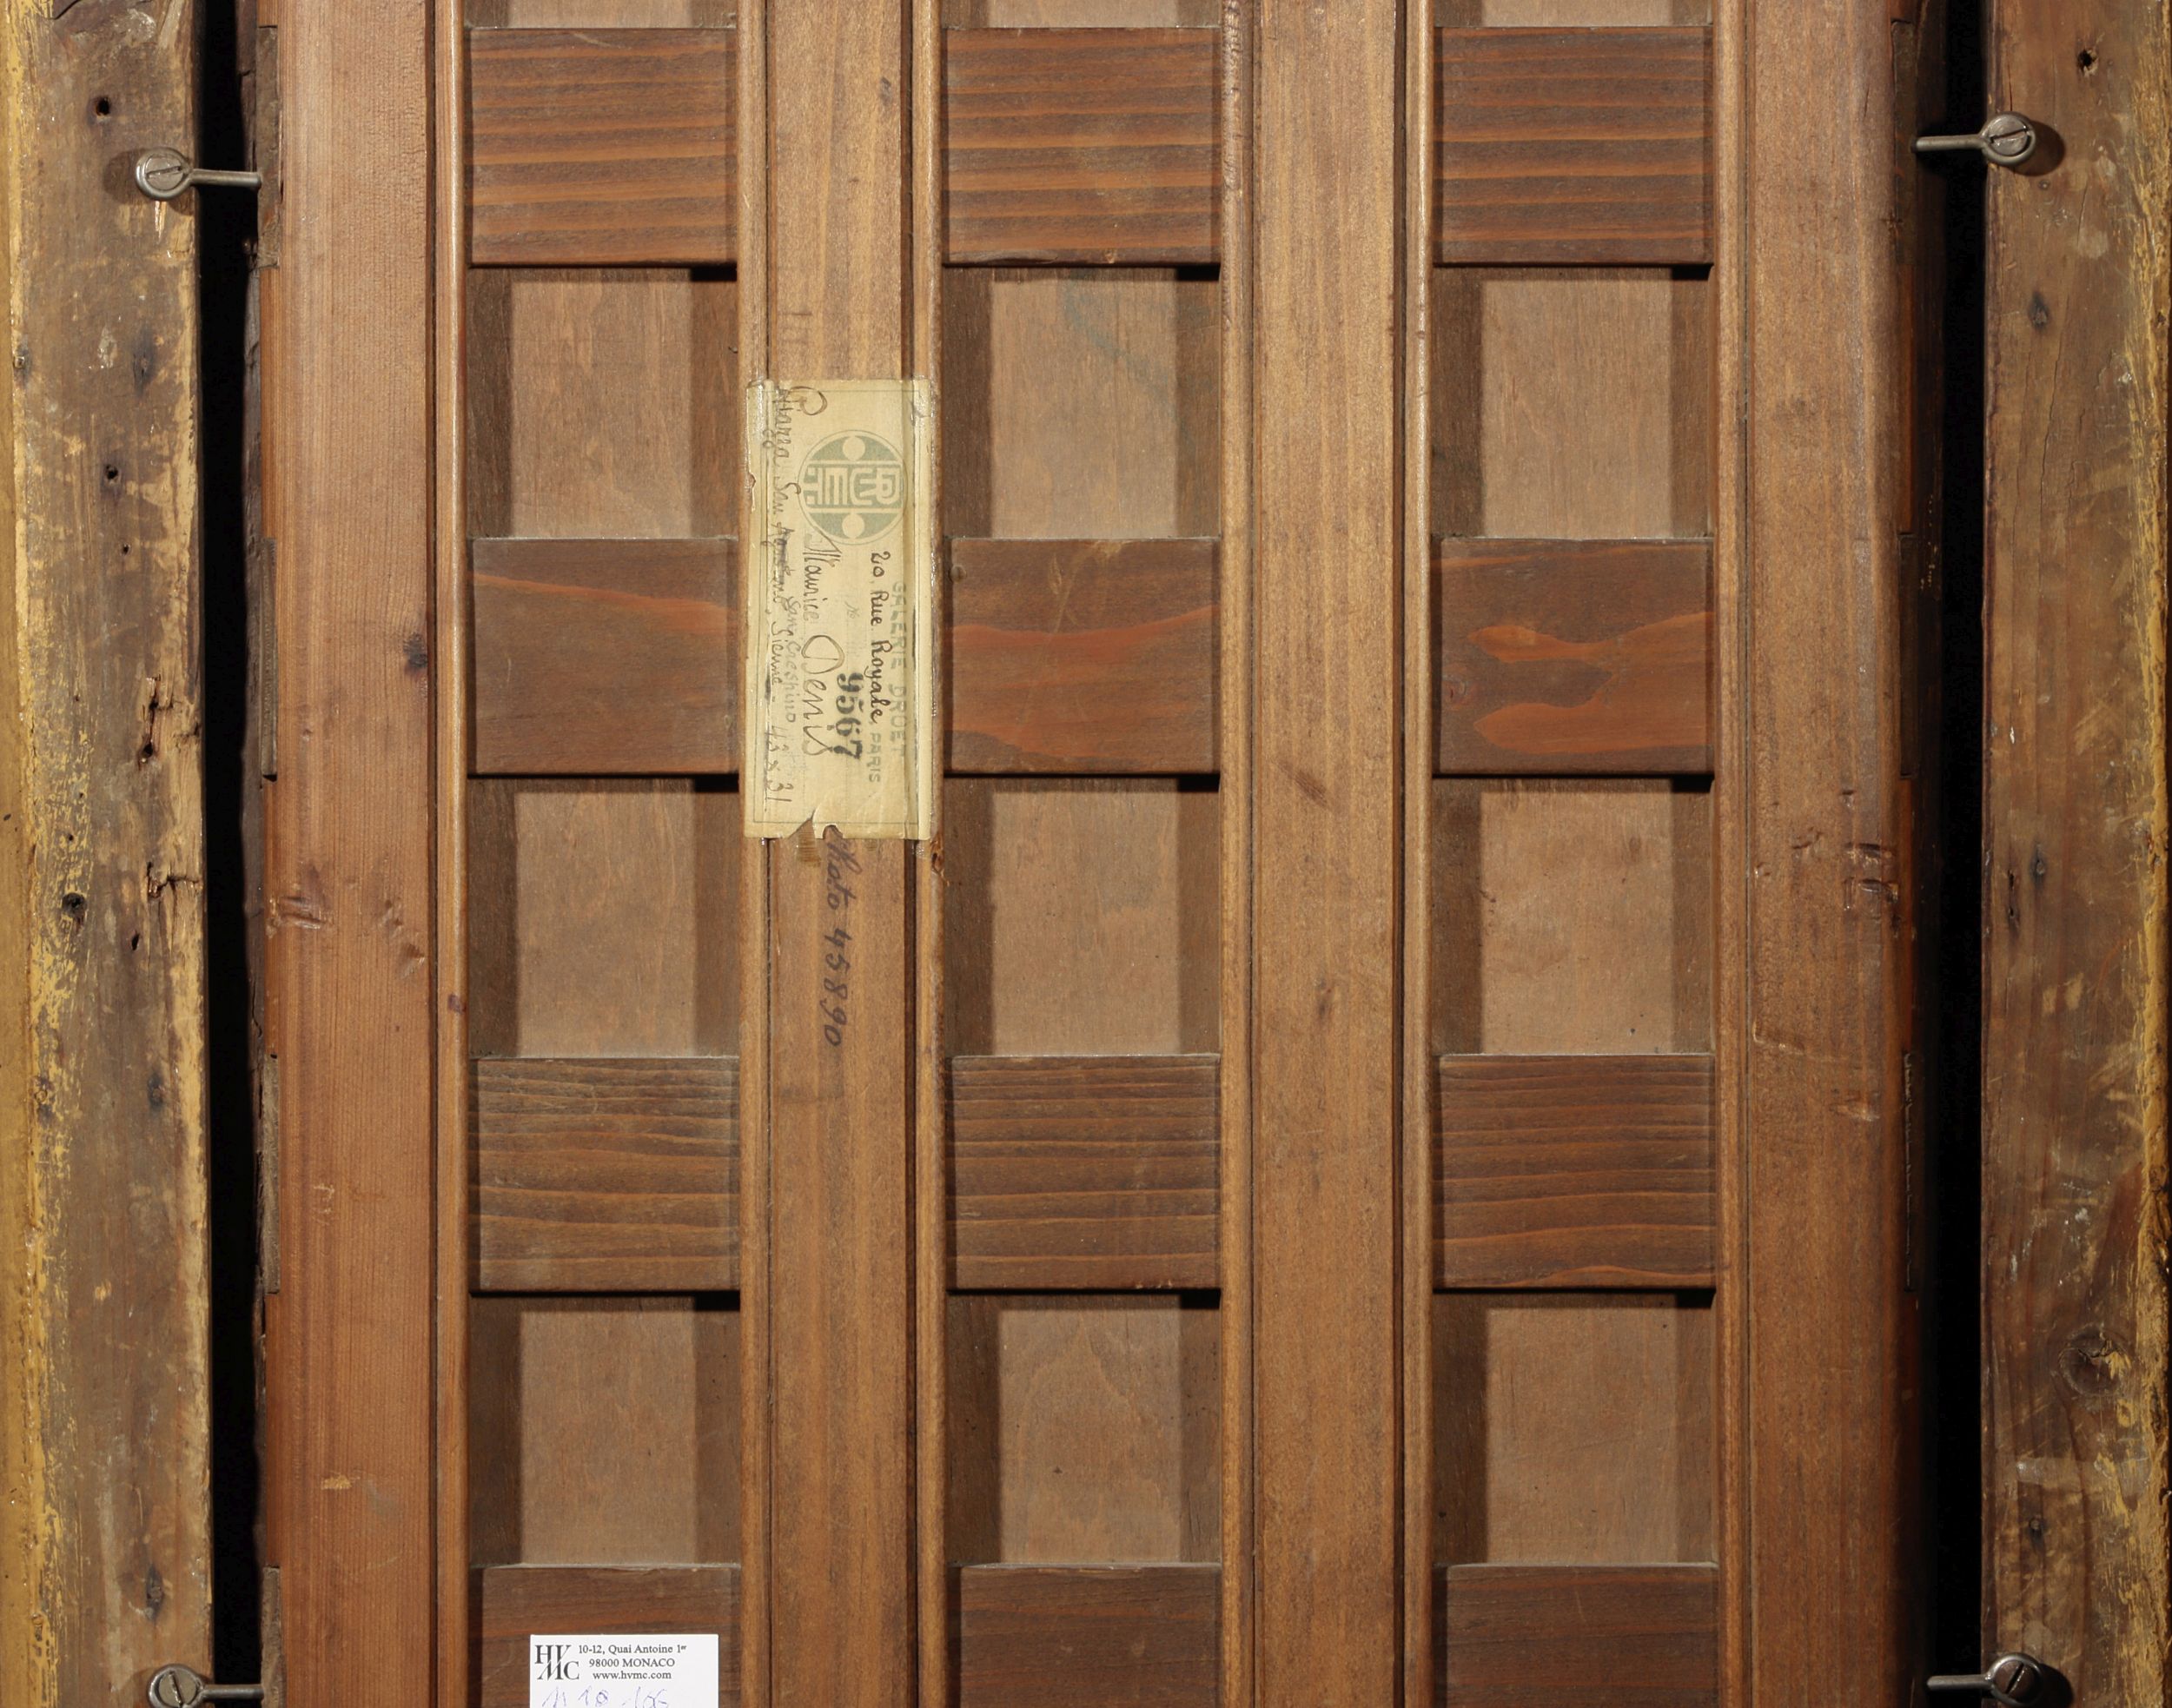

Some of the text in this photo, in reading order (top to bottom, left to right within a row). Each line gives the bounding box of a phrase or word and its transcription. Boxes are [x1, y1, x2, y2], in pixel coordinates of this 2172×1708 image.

[802, 526, 845, 756] Maurice Denis
[889, 581, 907, 670] GALERIE
[833, 672, 864, 760] 9567
[866, 732, 882, 784] PARIS
[819, 927, 853, 1048] 45890
[579, 1645, 606, 1655] 10-12,
[608, 1645, 632, 1655] Quai
[634, 1645, 673, 1653] Antoine
[589, 1658, 675, 1667] 98000 MONACO
[593, 1670, 672, 1679] www.hvmc.com
